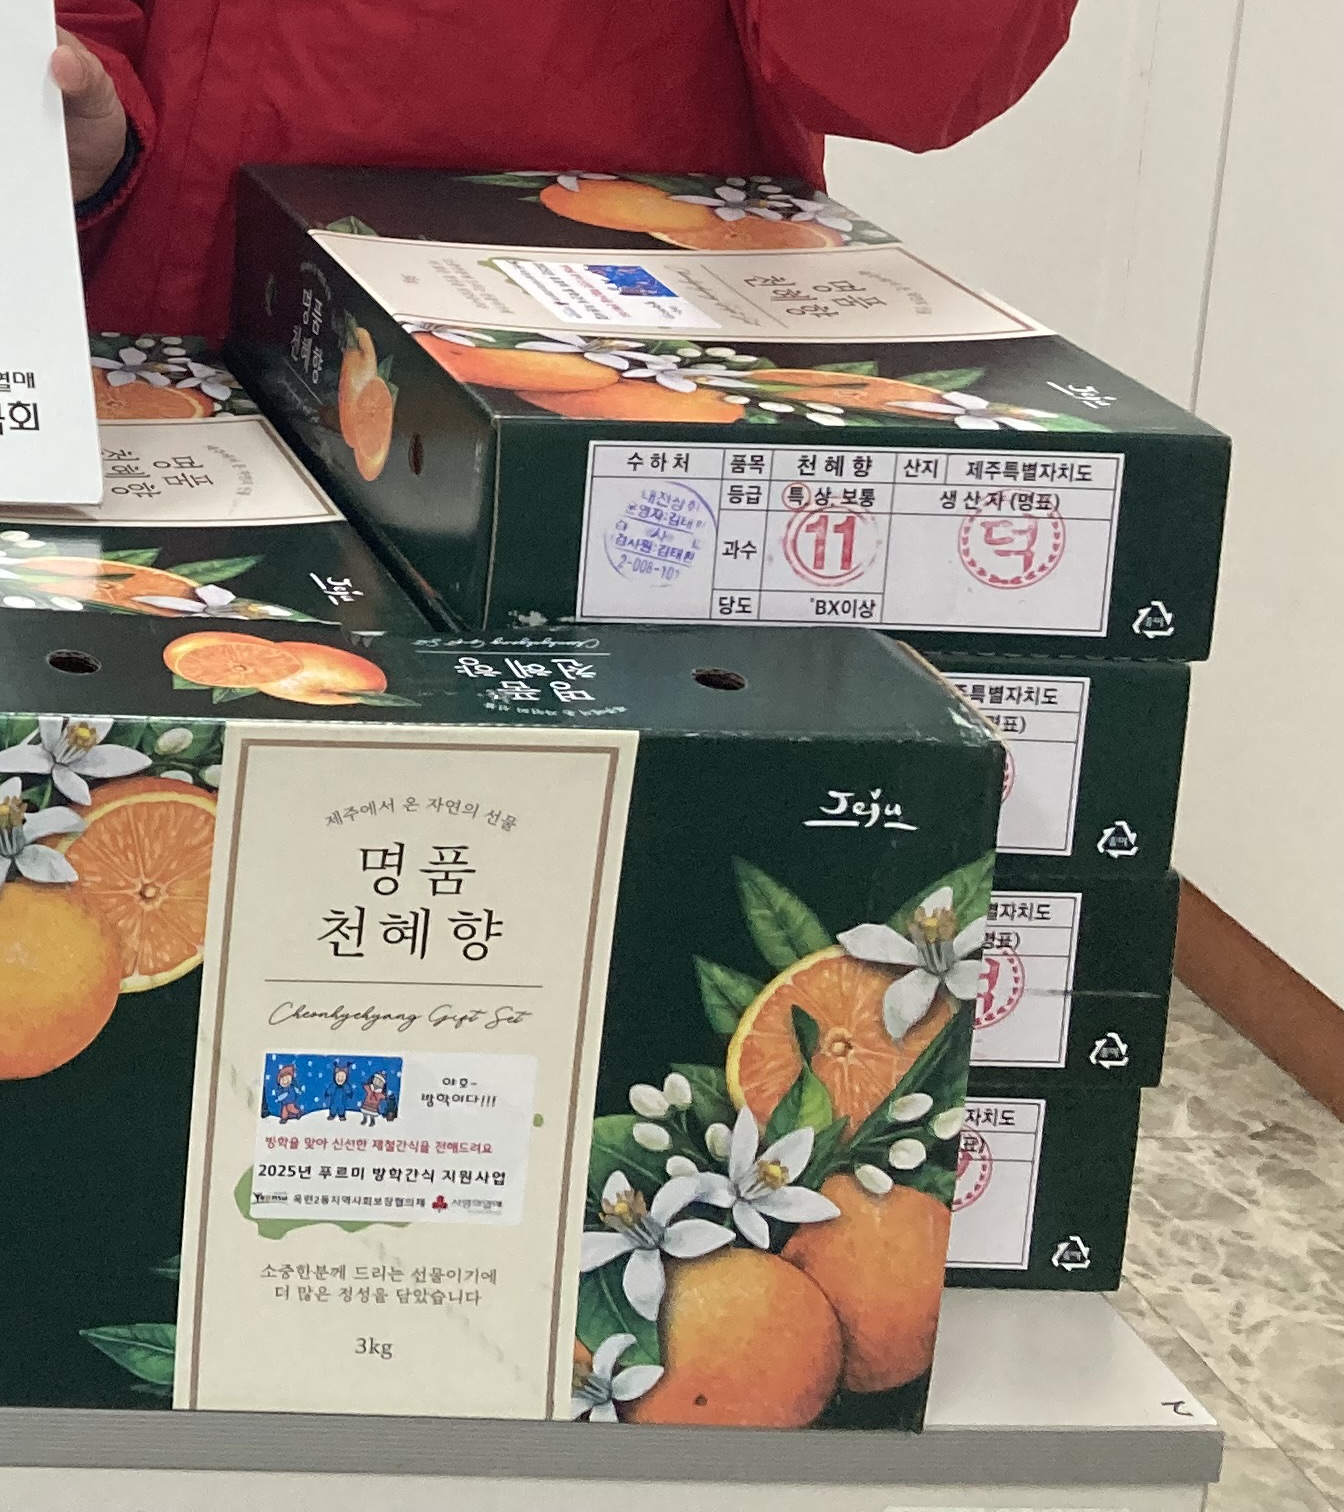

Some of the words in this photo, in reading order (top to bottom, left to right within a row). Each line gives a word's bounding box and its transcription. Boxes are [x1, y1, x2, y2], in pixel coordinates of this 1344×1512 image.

[627, 452, 689, 472] 수하처
[730, 454, 765, 474] 품목
[797, 455, 873, 477] 천혜향
[904, 459, 938, 479] 산지
[966, 461, 1093, 482] 제주특별자치도
[727, 485, 762, 505] 등급
[842, 487, 875, 507] 보통
[721, 539, 757, 560] 과수
[805, 514, 856, 571] 11
[718, 595, 752, 616] 당도
[426, 798, 480, 819] 자연의
[819, 788, 902, 828] Jeju
[359, 841, 476, 897] 명품
[317, 904, 504, 961] 천혜향
[257, 1163, 312, 1181] 2025년
[318, 1165, 366, 1182] 푸르미
[372, 1166, 436, 1184] 방학간식
[442, 1168, 506, 1186] 지원사업
[259, 1262, 347, 1282] 소중한분께
[353, 1265, 405, 1283] 드리는
[411, 1266, 497, 1286] 선물이기에
[274, 1284, 290, 1301] 더
[297, 1285, 331, 1303] 많은
[338, 1286, 389, 1305] 정성을
[396, 1288, 482, 1307] 담았습니다
[354, 1337, 393, 1360] 3kg
